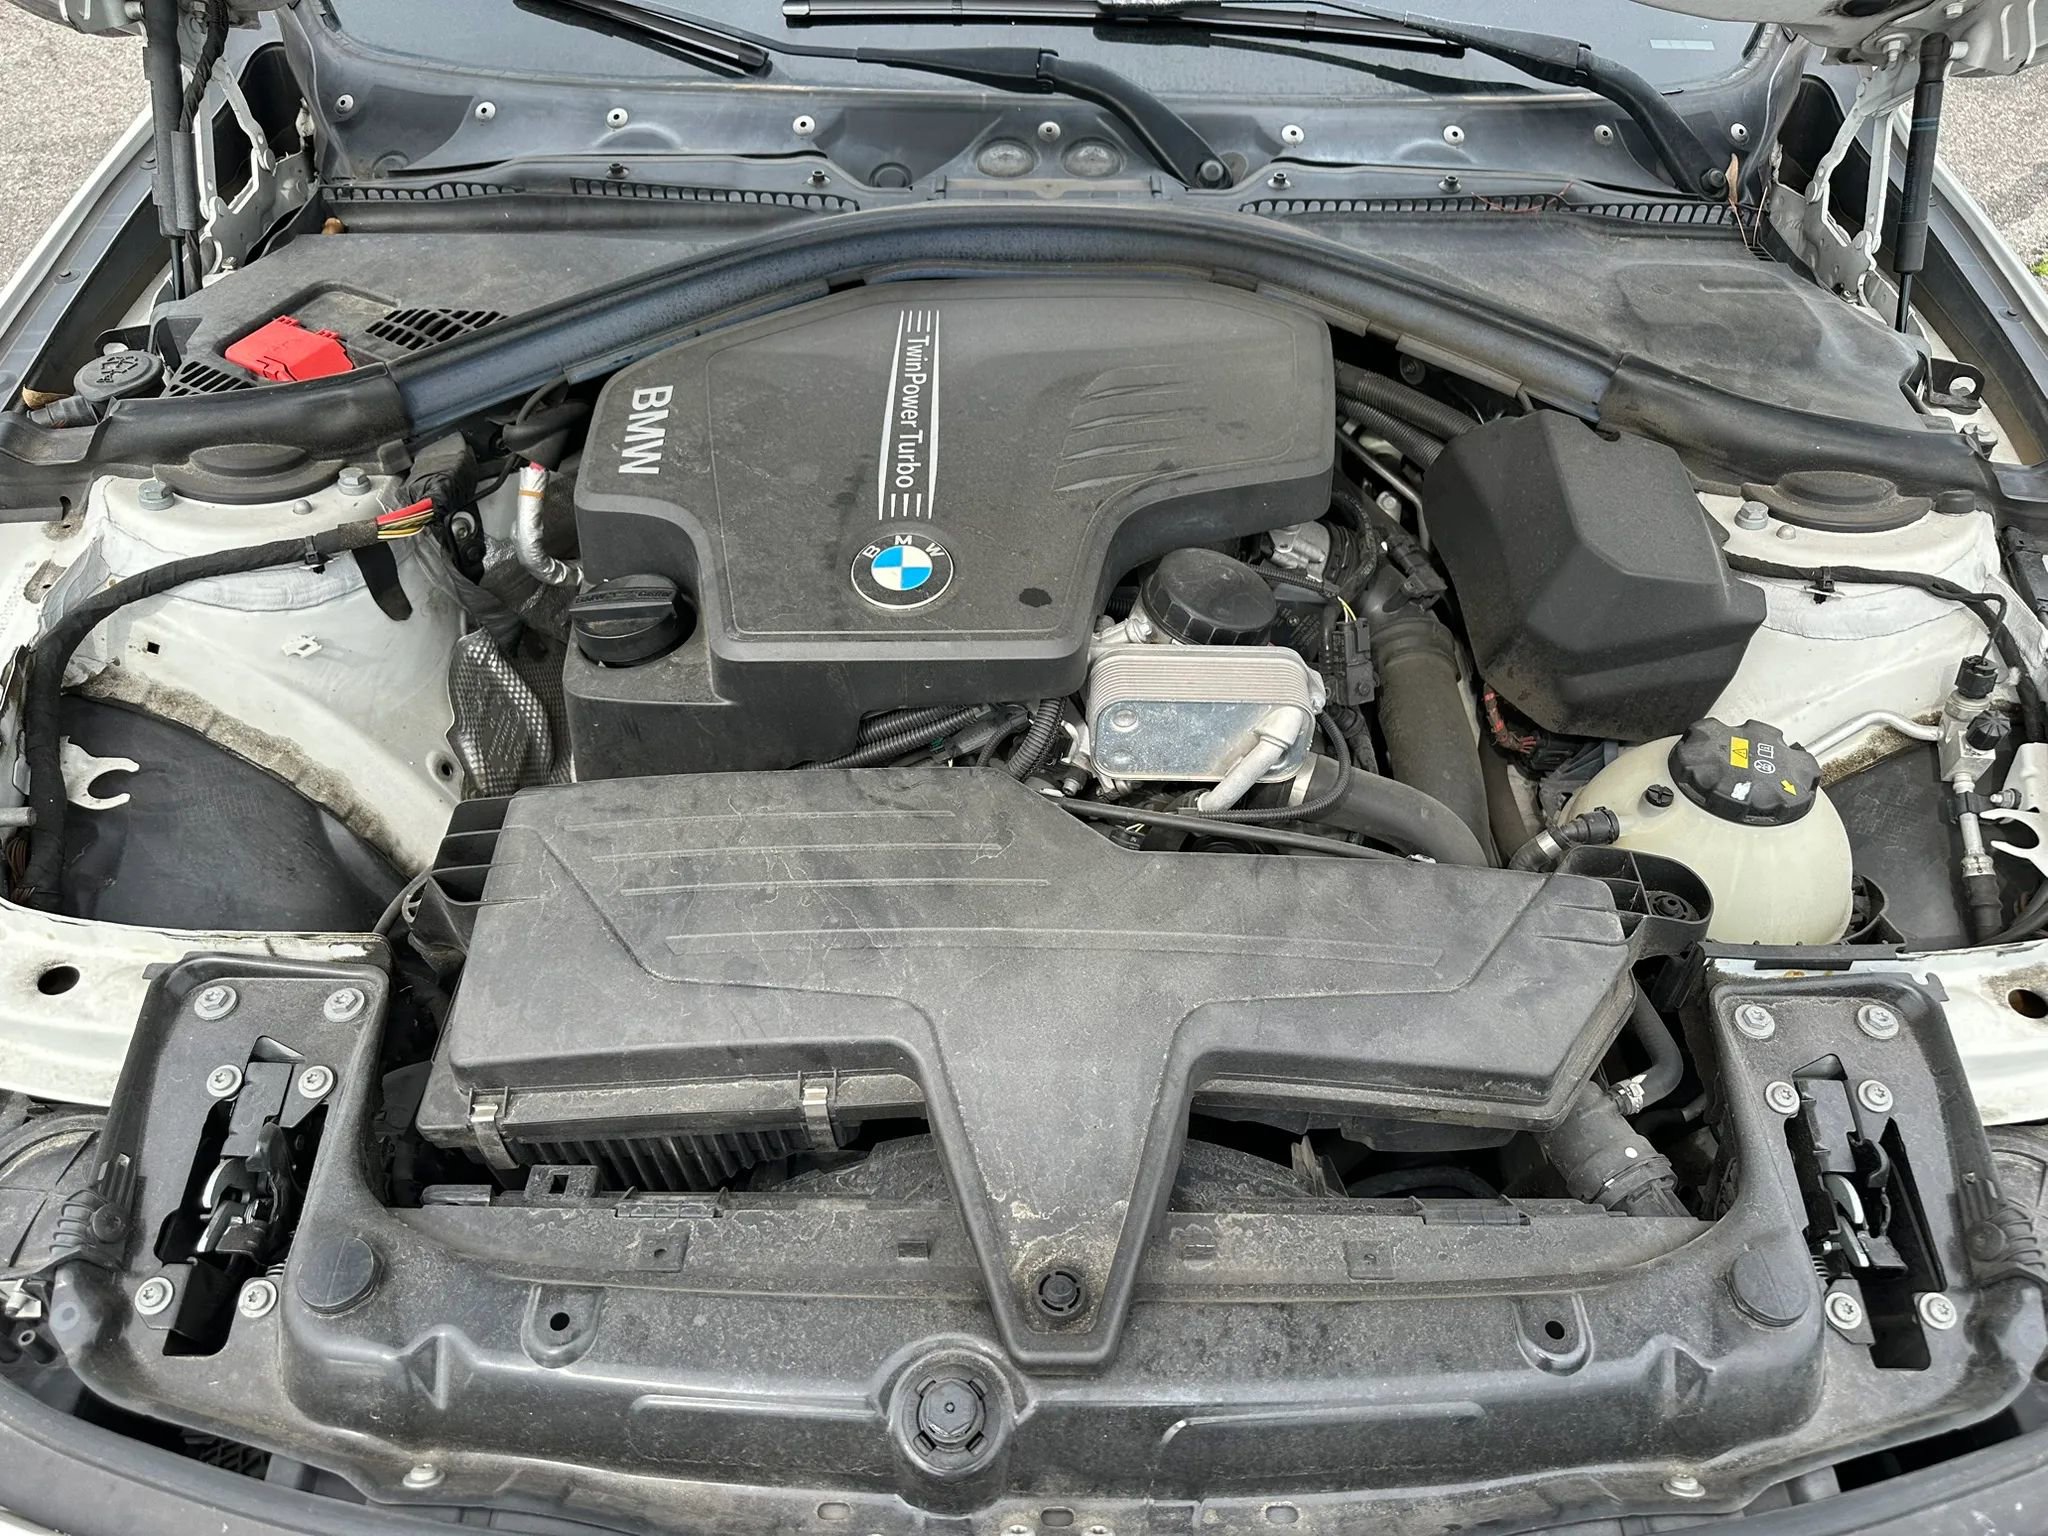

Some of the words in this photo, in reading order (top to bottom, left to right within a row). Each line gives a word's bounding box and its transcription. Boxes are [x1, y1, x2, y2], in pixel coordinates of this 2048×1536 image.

[900, 335, 930, 428] TwinPower
[618, 385, 674, 474] BMW
[895, 429, 924, 489] Turbo
[862, 535, 945, 559] BMW
